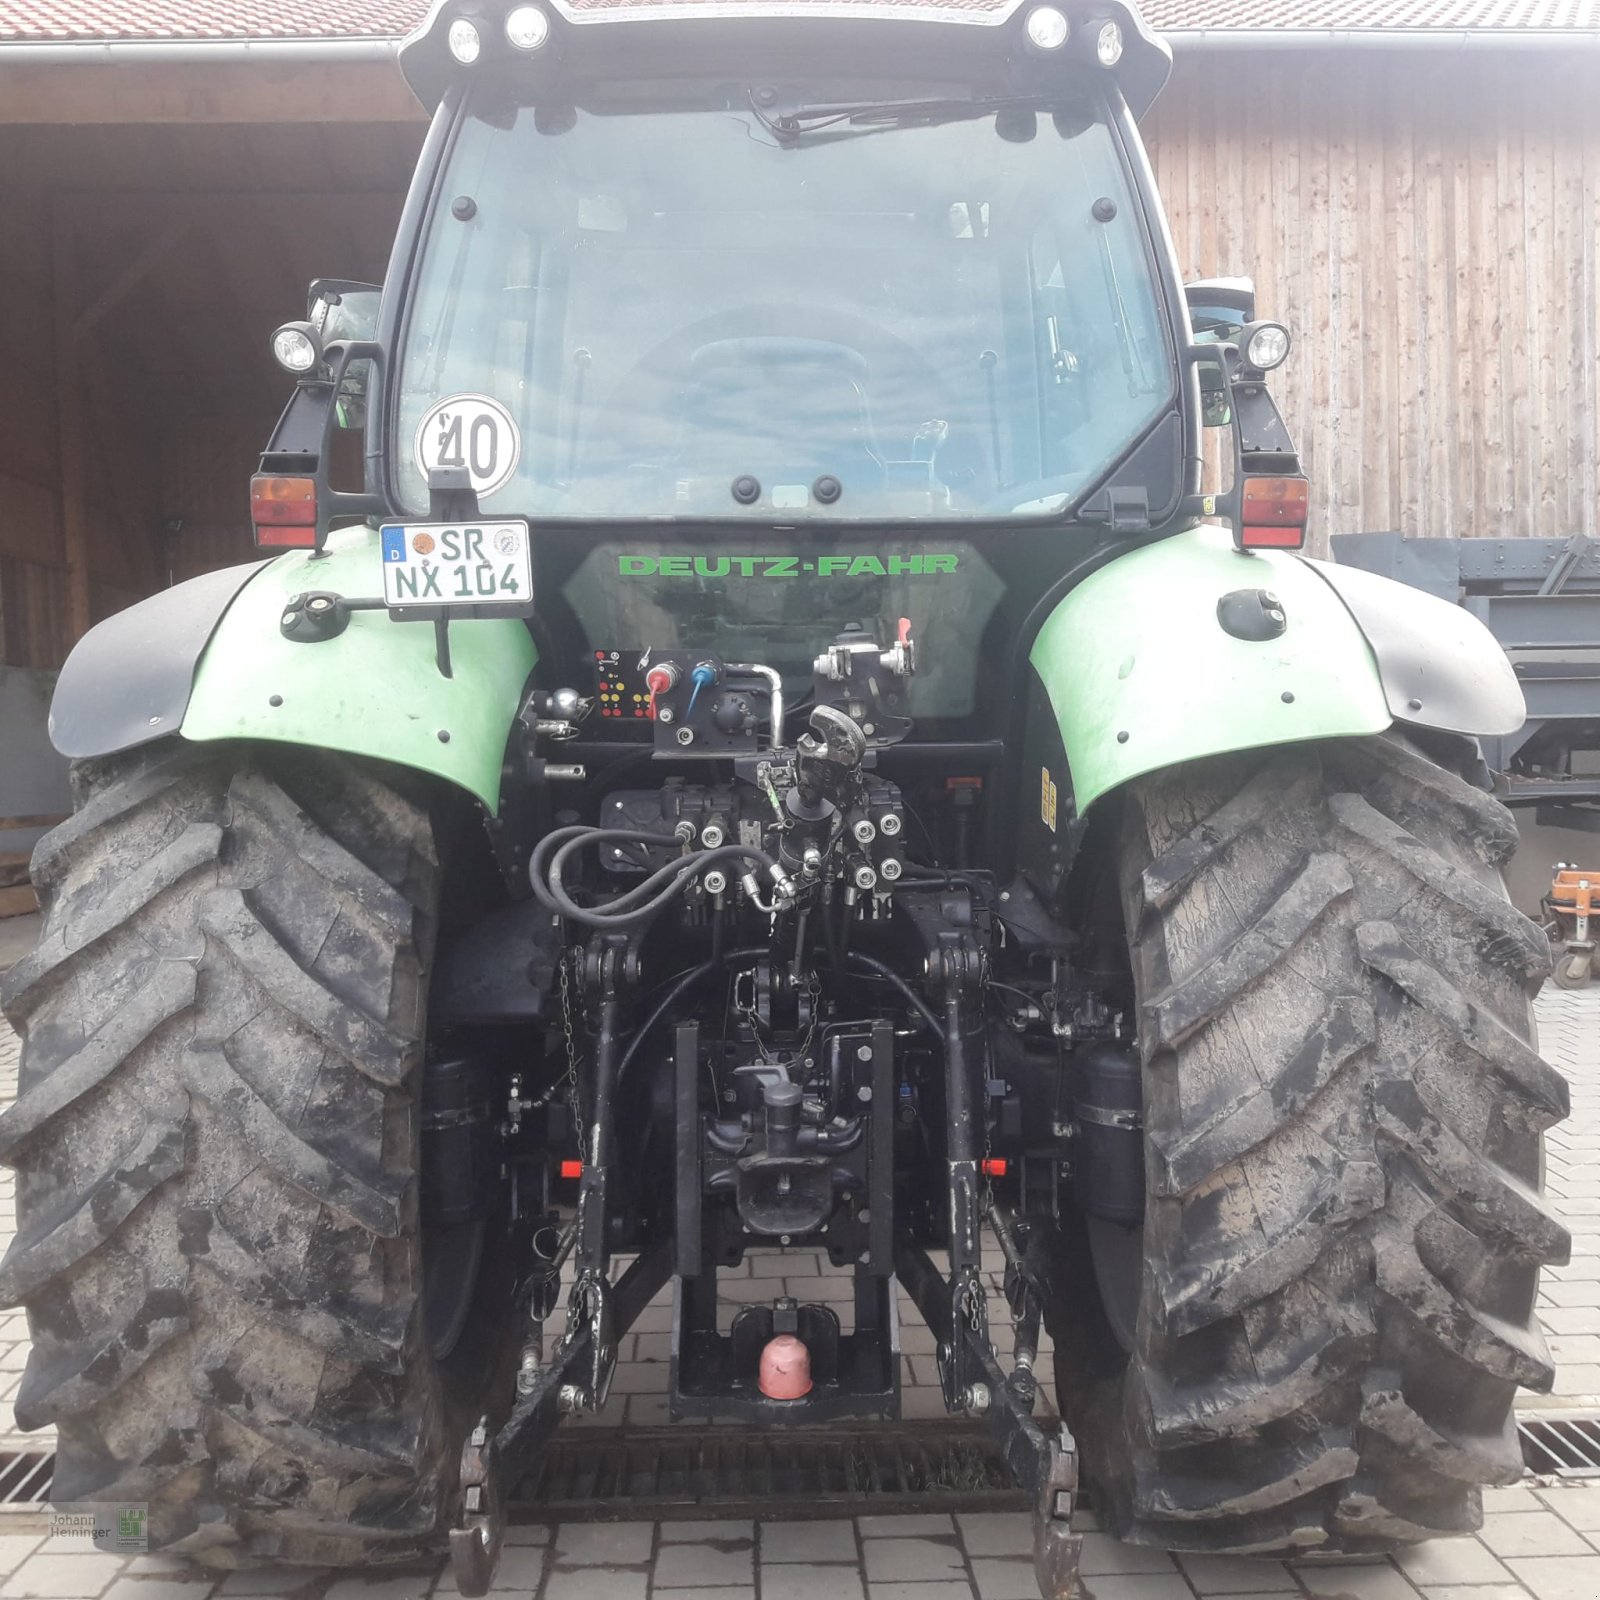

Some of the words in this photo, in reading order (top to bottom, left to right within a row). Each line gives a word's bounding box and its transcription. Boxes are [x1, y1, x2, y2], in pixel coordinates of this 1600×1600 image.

[437, 413, 498, 479] 40
[391, 549, 400, 561] D
[440, 528, 486, 562] SR
[395, 565, 443, 599] NX
[453, 562, 520, 597] 104
[618, 553, 960, 578] DEUTZ-FAHR
